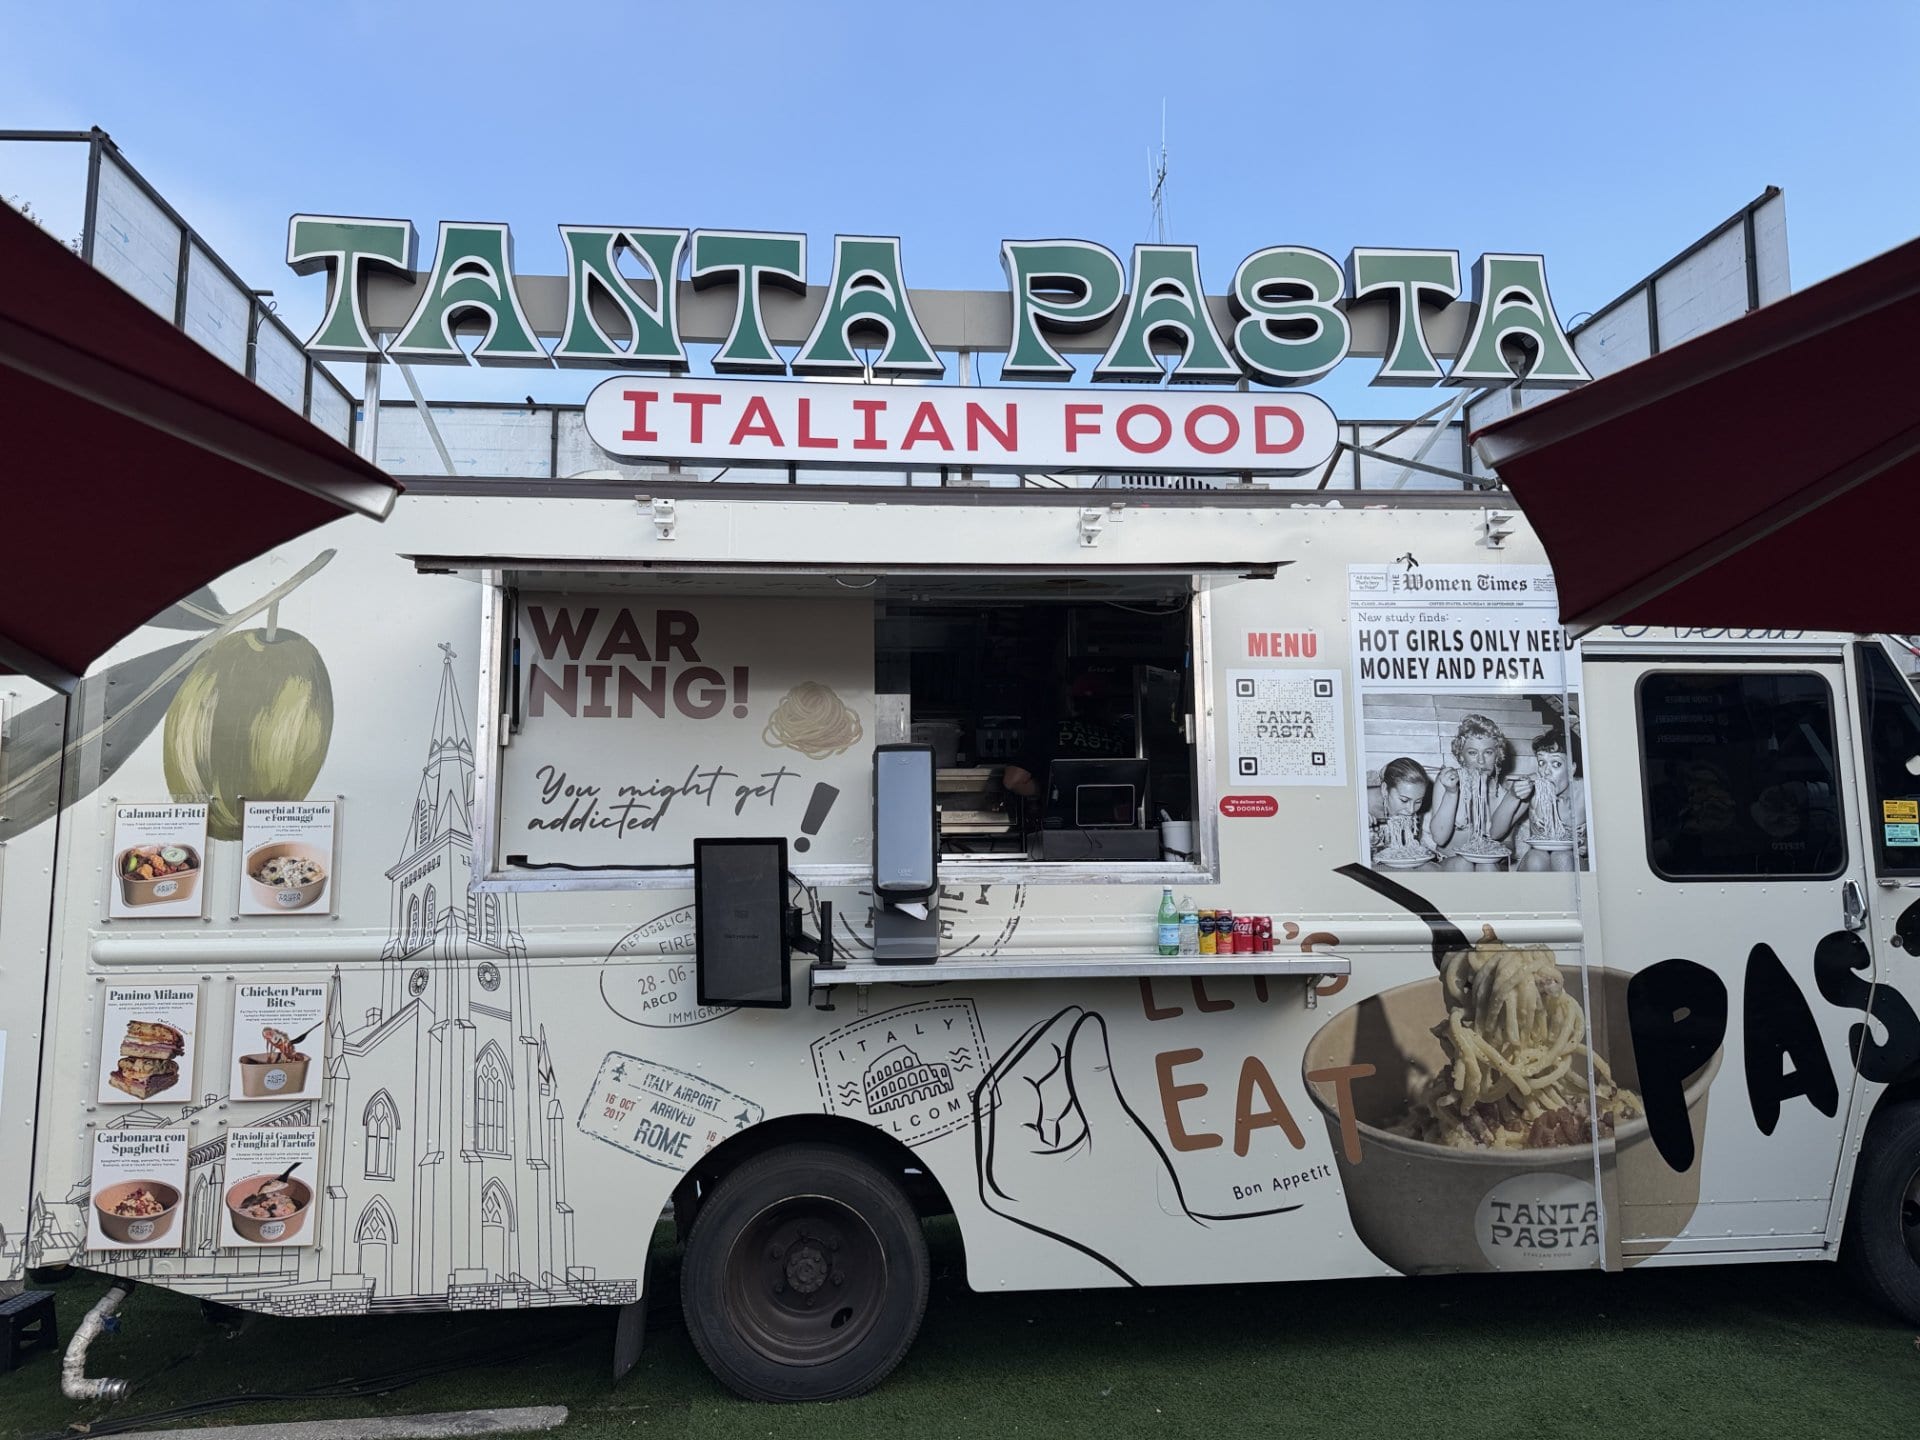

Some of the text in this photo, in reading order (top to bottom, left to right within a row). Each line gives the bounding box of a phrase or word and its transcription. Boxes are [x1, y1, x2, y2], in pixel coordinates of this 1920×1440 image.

[286, 214, 1593, 389] TANTA PASTA
[621, 390, 1306, 455] ITALIAN FOOD
[1392, 574, 1400, 593] THE
[1403, 574, 1472, 592] Women
[1477, 574, 1527, 592] Times
[1358, 612, 1449, 627] New study finds:
[527, 606, 702, 662] WAR
[1359, 629, 1575, 652] HOT GIRLS ONLY NEED
[1248, 632, 1317, 658] MENU
[1361, 657, 1544, 680] MONEY AND PASTA
[528, 663, 749, 719] NING!
[1256, 711, 1314, 724] TANTA
[1256, 724, 1315, 738] PASTA
[536, 764, 802, 816] You might get
[118, 808, 206, 818] Calamari Fritti
[250, 806, 330, 814] Gnocchi al Tartufo
[272, 814, 314, 822] Formaggi
[528, 798, 668, 840] addicted
[620, 911, 692, 951] REPUBBLICA
[659, 932, 696, 953] FIRE
[638, 975, 657, 995] 28
[668, 965, 686, 985] 06
[110, 990, 194, 1000] Panino Milano
[241, 986, 322, 996] Chicken Parm
[643, 991, 677, 1011] ABCD
[267, 998, 296, 1007] Bites
[669, 1006, 729, 1024] IMMIGRA
[839, 1019, 954, 1061] ITALY
[1627, 899, 1920, 1173] PAS
[642, 1073, 673, 1093] ITALY
[605, 1093, 636, 1112] 16 OCT
[874, 1090, 976, 1132] LCOME
[1155, 1047, 1376, 1165] EAT
[603, 1107, 626, 1122] 2017
[98, 1132, 186, 1142] Carbonara con
[232, 1132, 263, 1140] Ravioli
[276, 1132, 315, 1140] Gamberi
[238, 1140, 269, 1150] Funghi
[270, 1140, 279, 1148] al
[282, 1139, 316, 1148] Tartufo
[633, 1118, 692, 1159] ROME
[112, 1143, 170, 1156] Spaghetti
[1232, 1164, 1332, 1200] Bon Appetit
[1491, 1201, 1598, 1225] TANTA
[1491, 1224, 1599, 1249] PASTA
